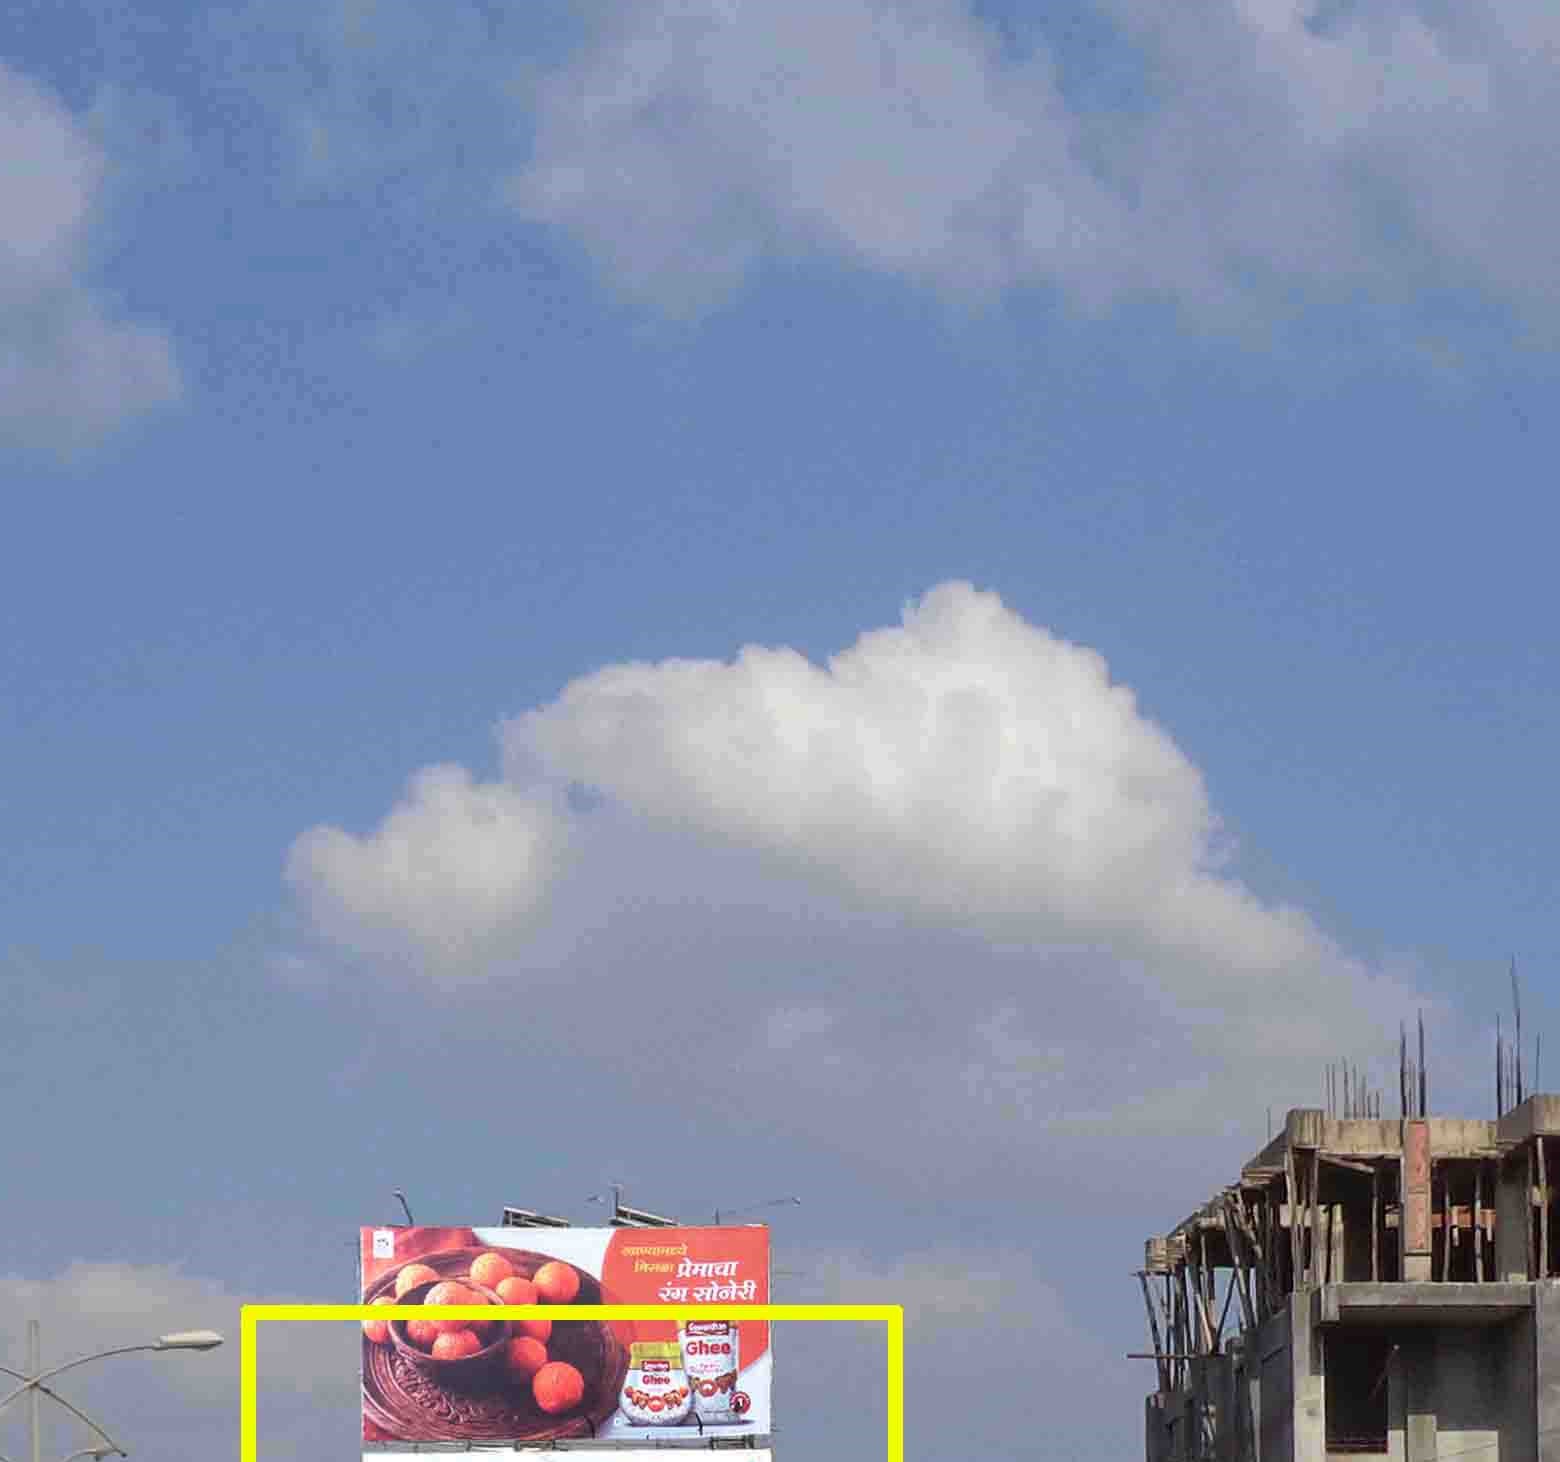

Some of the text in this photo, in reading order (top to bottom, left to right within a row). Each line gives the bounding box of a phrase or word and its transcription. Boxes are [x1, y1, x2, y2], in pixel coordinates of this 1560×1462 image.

[676, 1256, 740, 1279] प्रेमाचा
[658, 1279, 758, 1302] रंग सोनेरी
[686, 1340, 731, 1356] Ghee
[642, 1374, 671, 1385] Ghee
